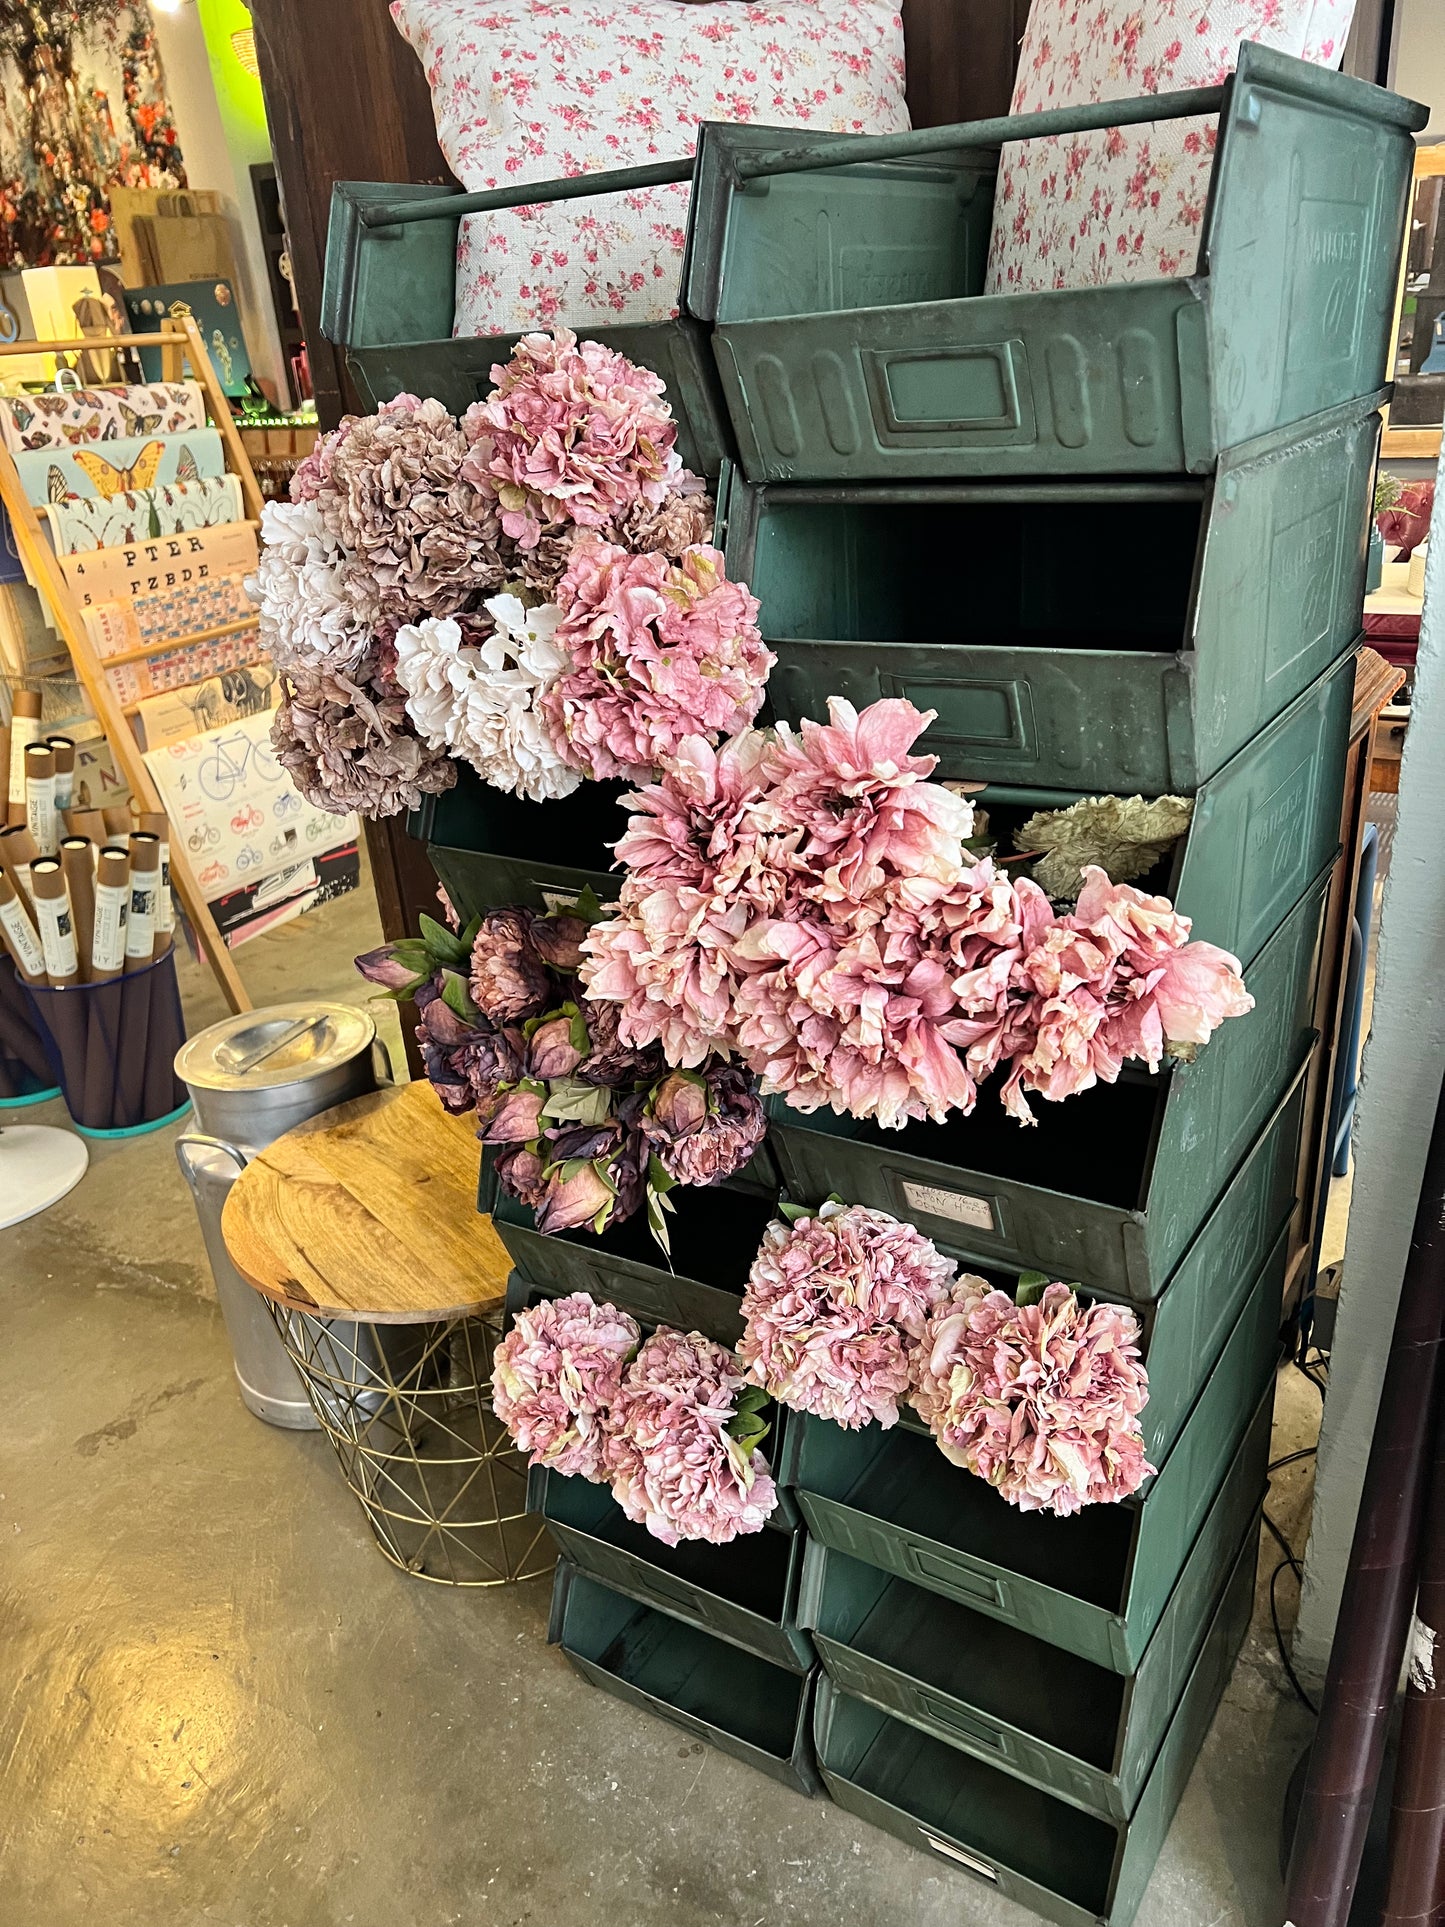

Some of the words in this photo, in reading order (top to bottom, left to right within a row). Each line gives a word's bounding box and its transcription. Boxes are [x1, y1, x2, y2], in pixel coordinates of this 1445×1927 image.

[77, 563, 85, 575] 4
[84, 594, 92, 605] 5
[130, 564, 210, 595] FZBDE
